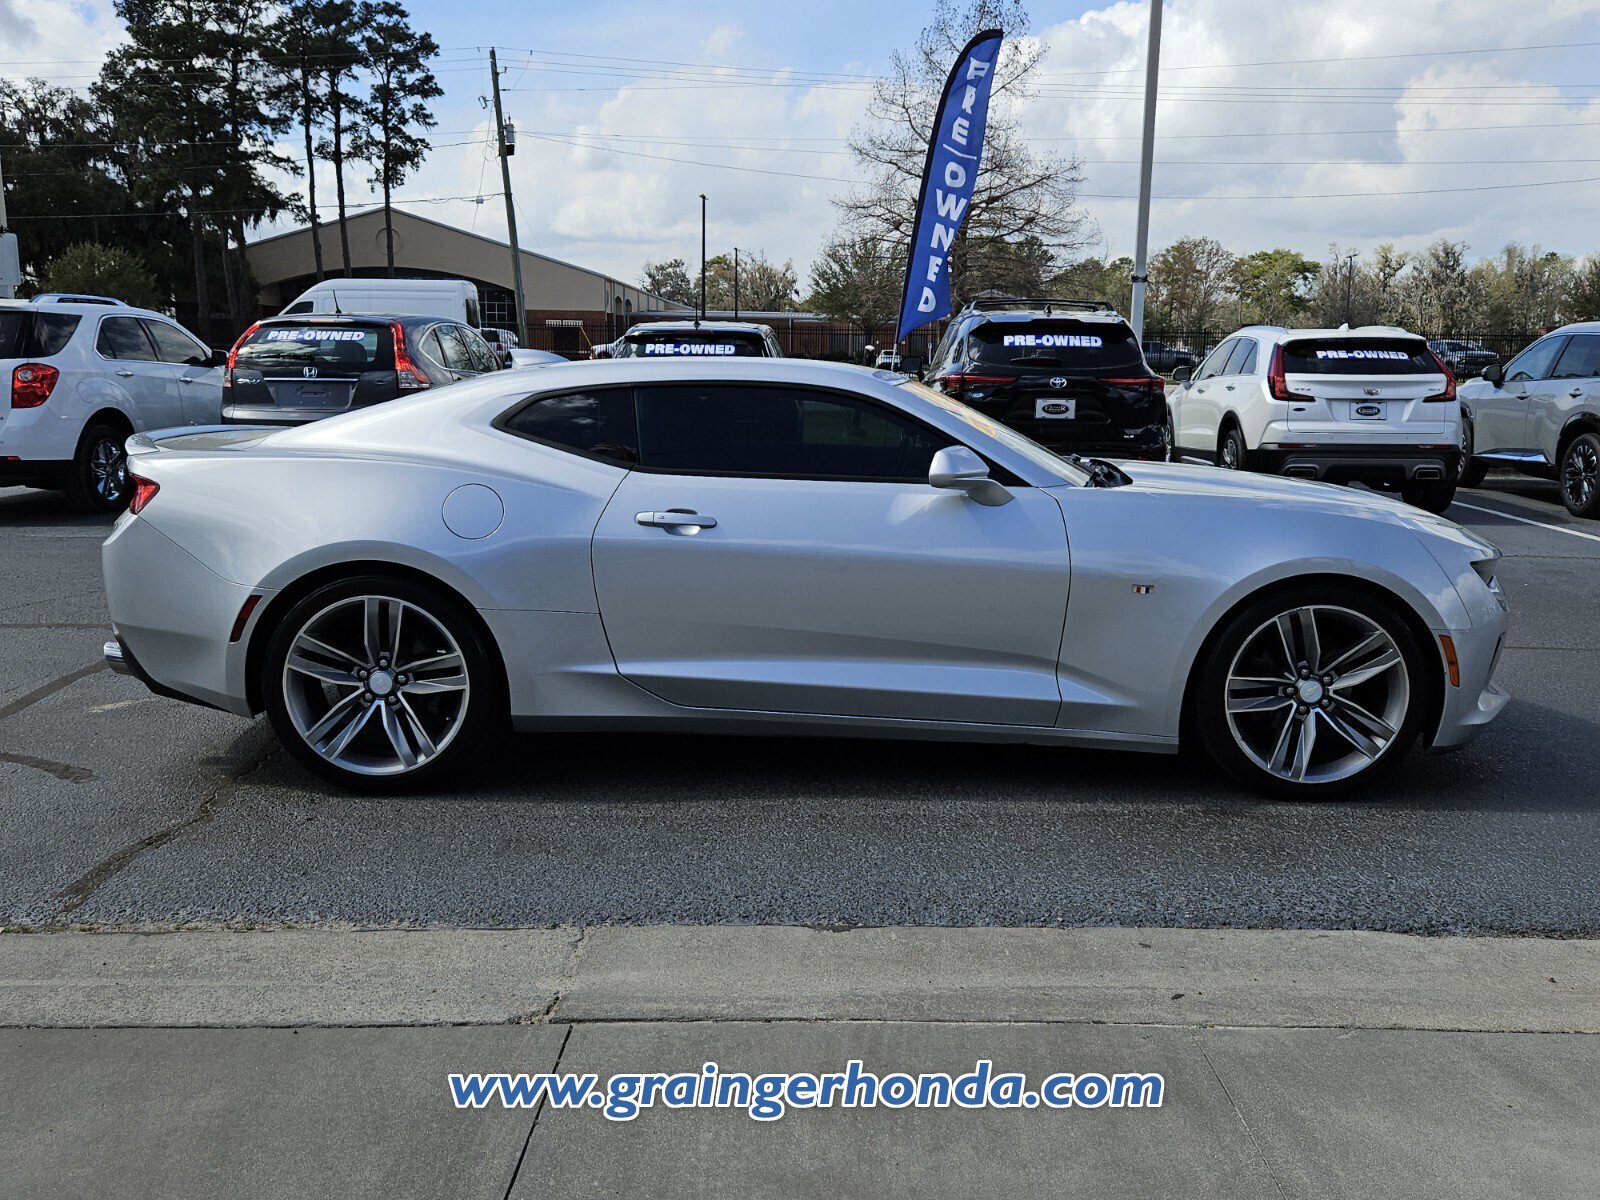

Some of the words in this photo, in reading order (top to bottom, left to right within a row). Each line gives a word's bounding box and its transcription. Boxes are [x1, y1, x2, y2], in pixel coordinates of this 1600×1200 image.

[266, 330, 365, 341] PRE-OWNED
[1003, 334, 1102, 347] PRE-OWNED
[645, 343, 735, 355] PRE-OWNED
[1316, 350, 1408, 360] PRE-OWNED
